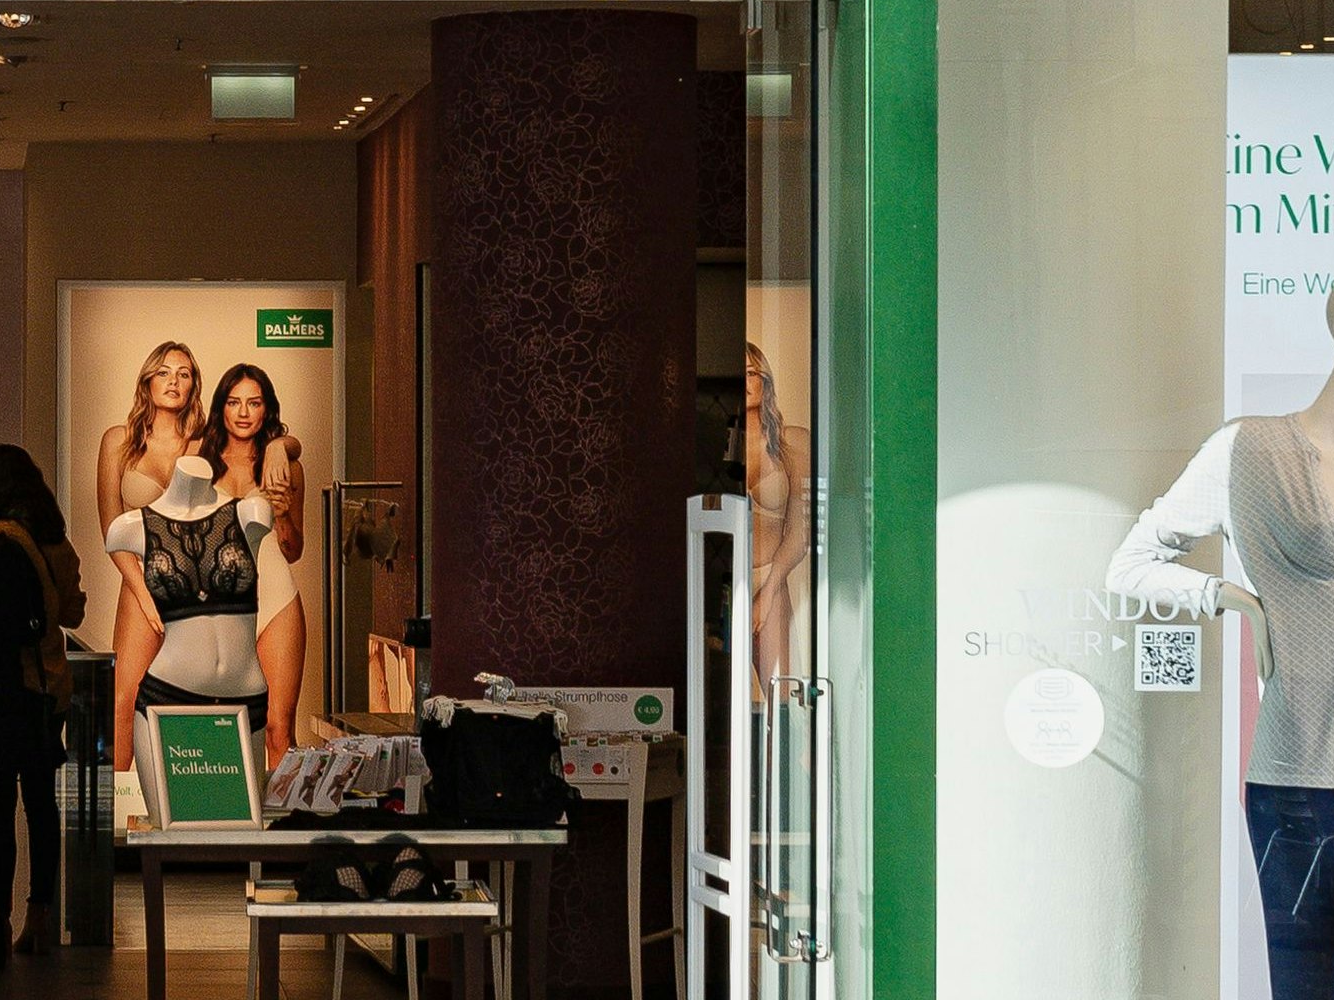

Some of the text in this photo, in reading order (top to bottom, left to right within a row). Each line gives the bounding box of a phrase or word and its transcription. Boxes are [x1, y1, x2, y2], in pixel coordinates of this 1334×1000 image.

[1226, 133, 1303, 176] ine
[1226, 202, 1263, 235] m
[1242, 272, 1296, 297] Eine
[265, 324, 325, 336] PALMERS
[168, 745, 204, 758] Neue
[171, 761, 239, 776] Kollektion
